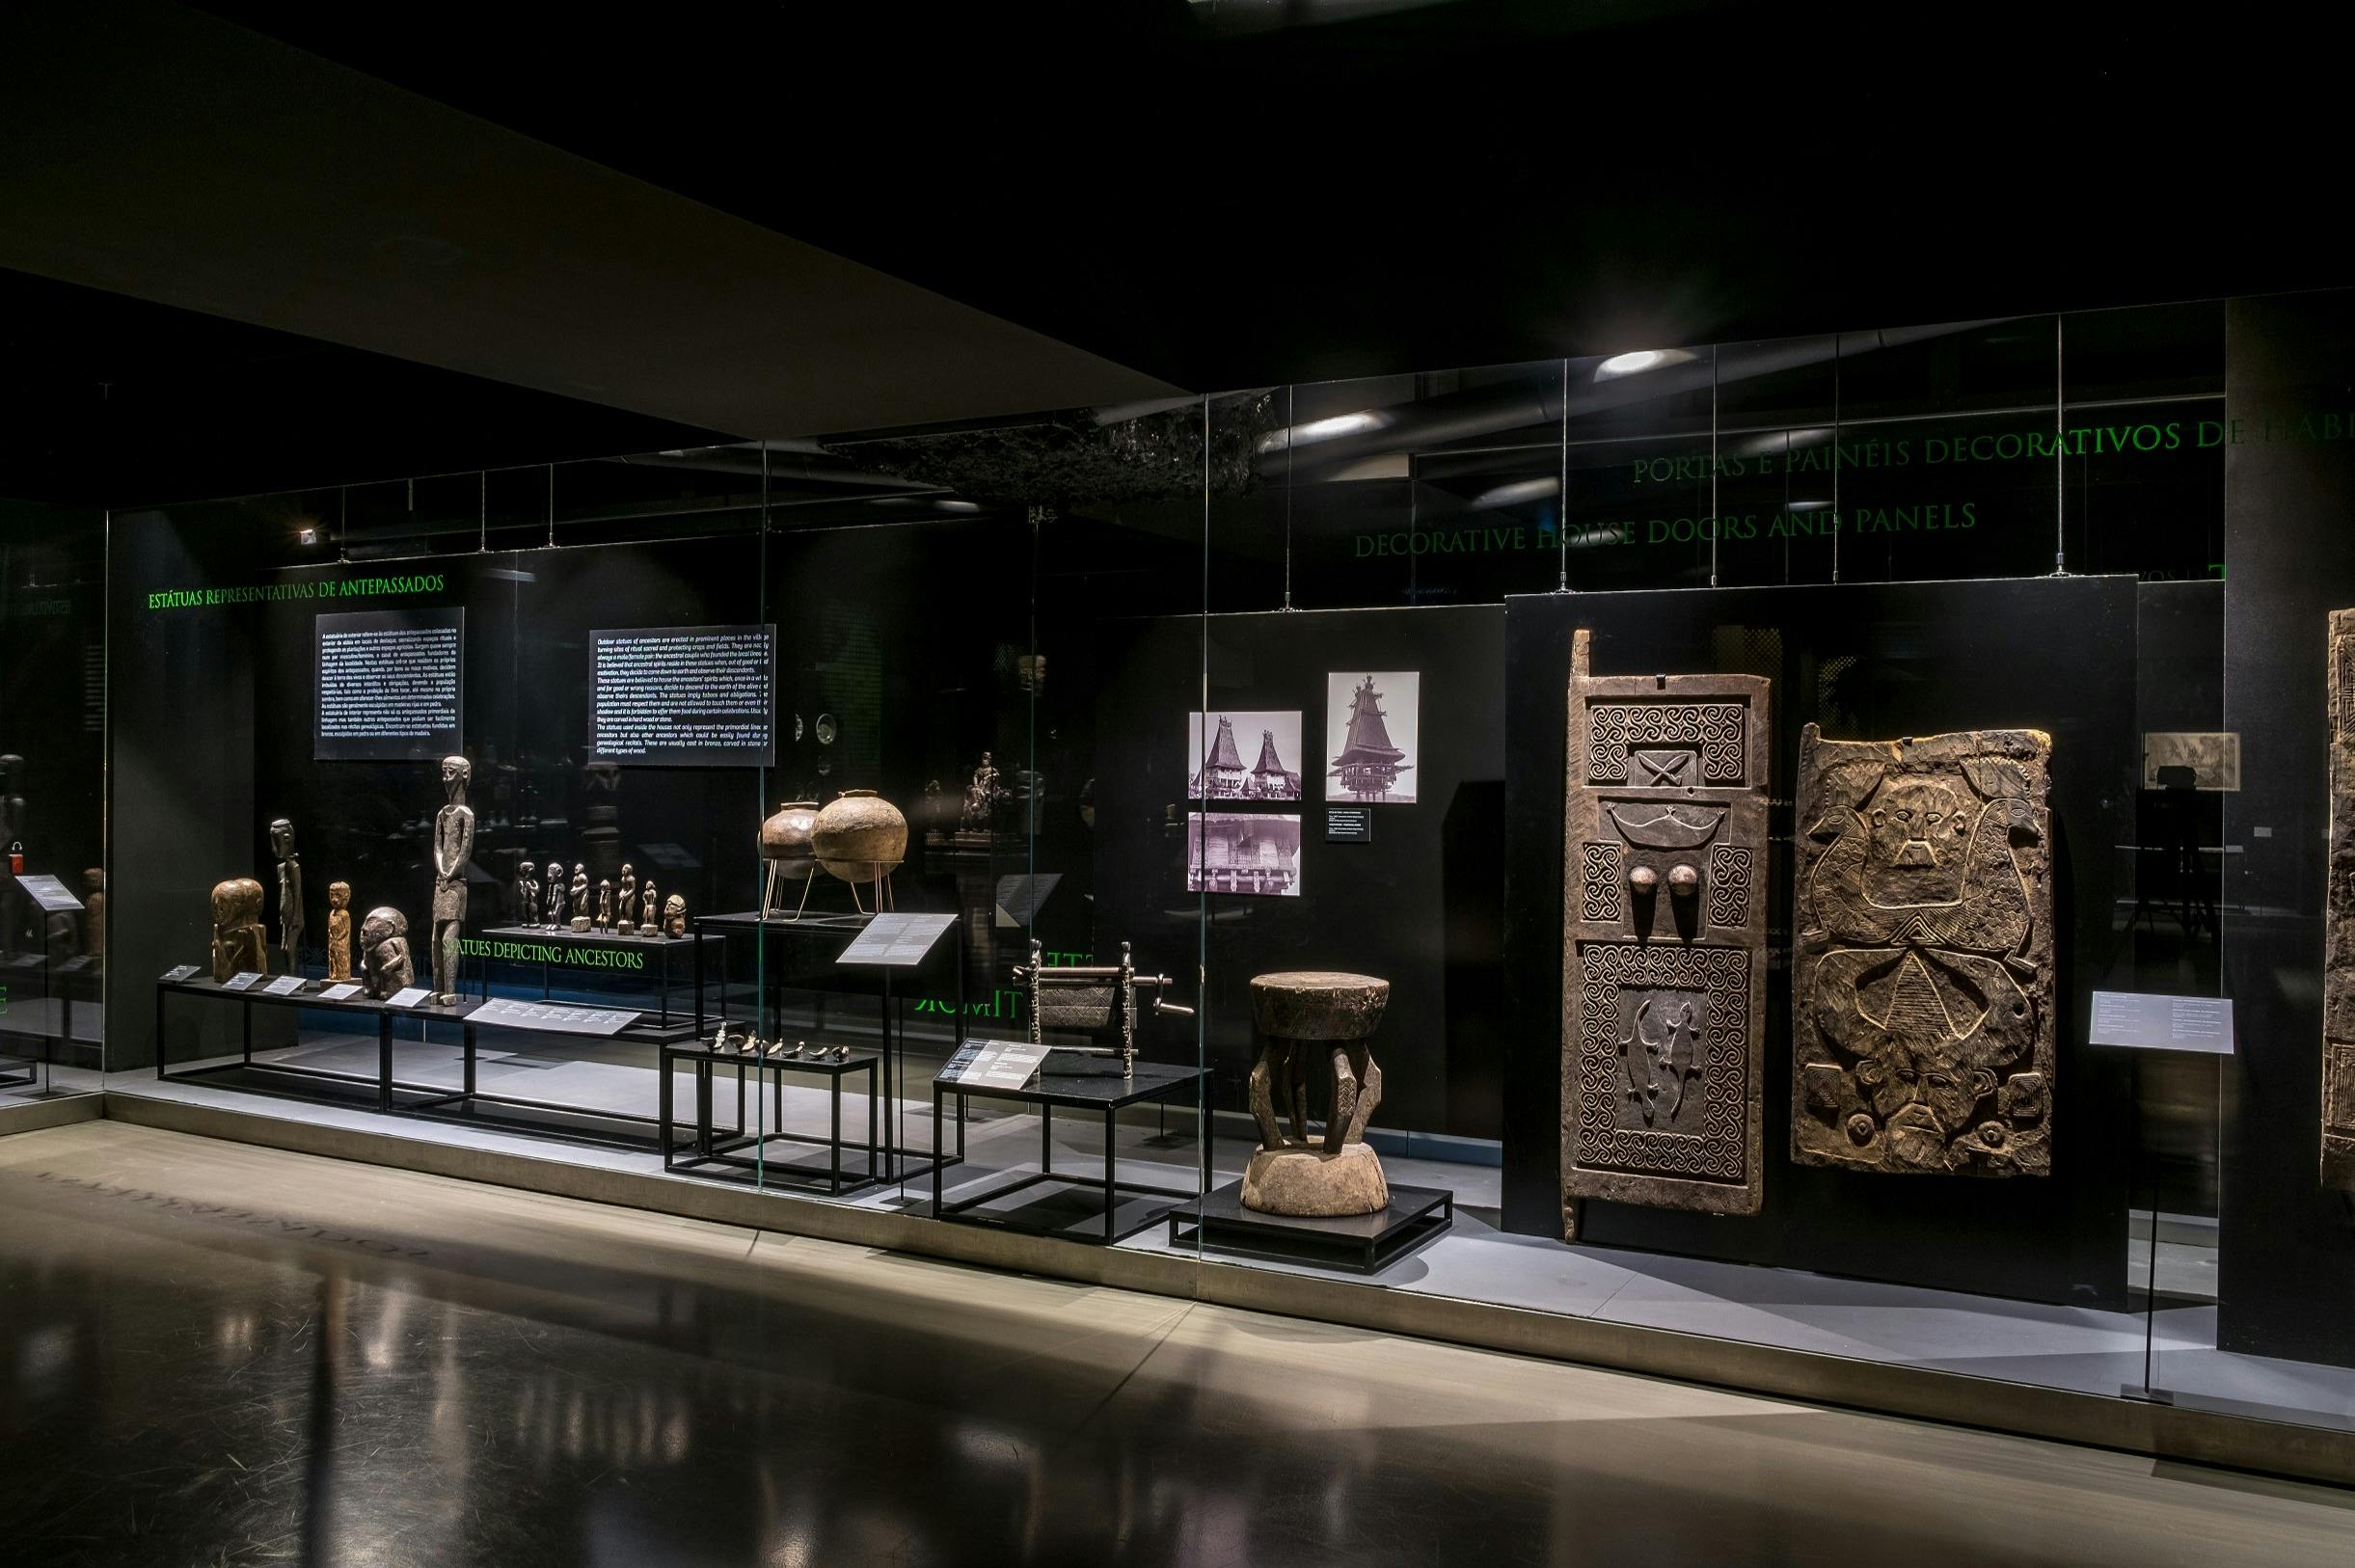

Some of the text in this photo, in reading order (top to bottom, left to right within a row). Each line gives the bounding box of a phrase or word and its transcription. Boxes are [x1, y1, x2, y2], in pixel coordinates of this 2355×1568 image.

[1634, 455, 1745, 482] PORTAS
[1759, 450, 1773, 474] E
[1786, 439, 1910, 473] PAINÉIS
[1926, 422, 2180, 463] DECORATIVOS
[2197, 419, 2245, 447] DE
[1355, 502, 1976, 557] DECORATIVE HOUSE DOORS AND PANELS
[149, 574, 444, 608] ESTÁTUAS REPRESENTATIVAS DE ANTEPASSADOS
[493, 942, 562, 962] DEPICTING
[565, 948, 643, 969] ANCESTORS
